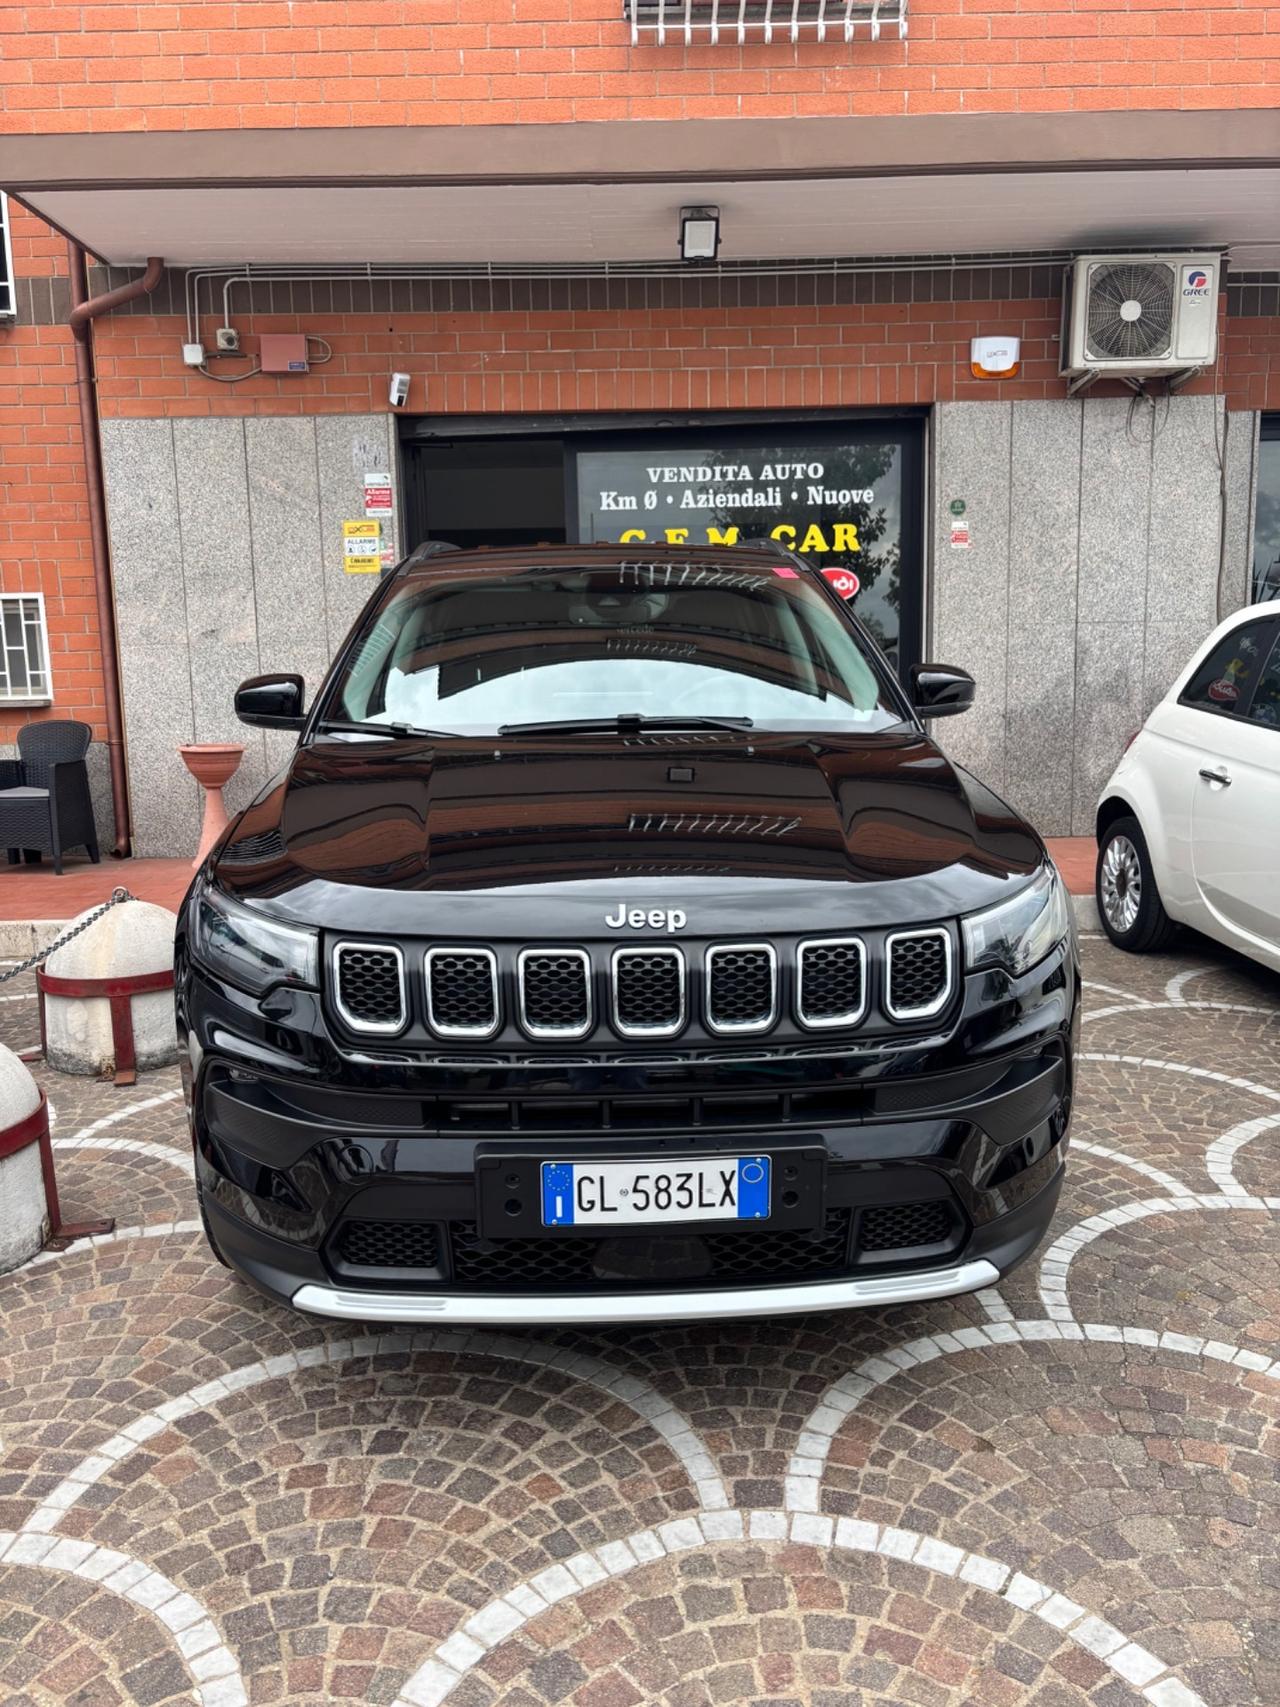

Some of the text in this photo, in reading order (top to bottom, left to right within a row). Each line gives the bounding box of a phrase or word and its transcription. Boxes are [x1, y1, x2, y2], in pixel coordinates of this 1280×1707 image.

[1182, 288, 1210, 297] GREE
[646, 462, 825, 483] VENDITA AUTO
[599, 491, 638, 511] Km
[680, 486, 783, 509] Aziendali
[806, 485, 875, 505] Nuove
[770, 523, 861, 553] CAR
[604, 903, 688, 934] Jeep
[576, 1175, 619, 1213] GL
[631, 1169, 737, 1212] 583LX
